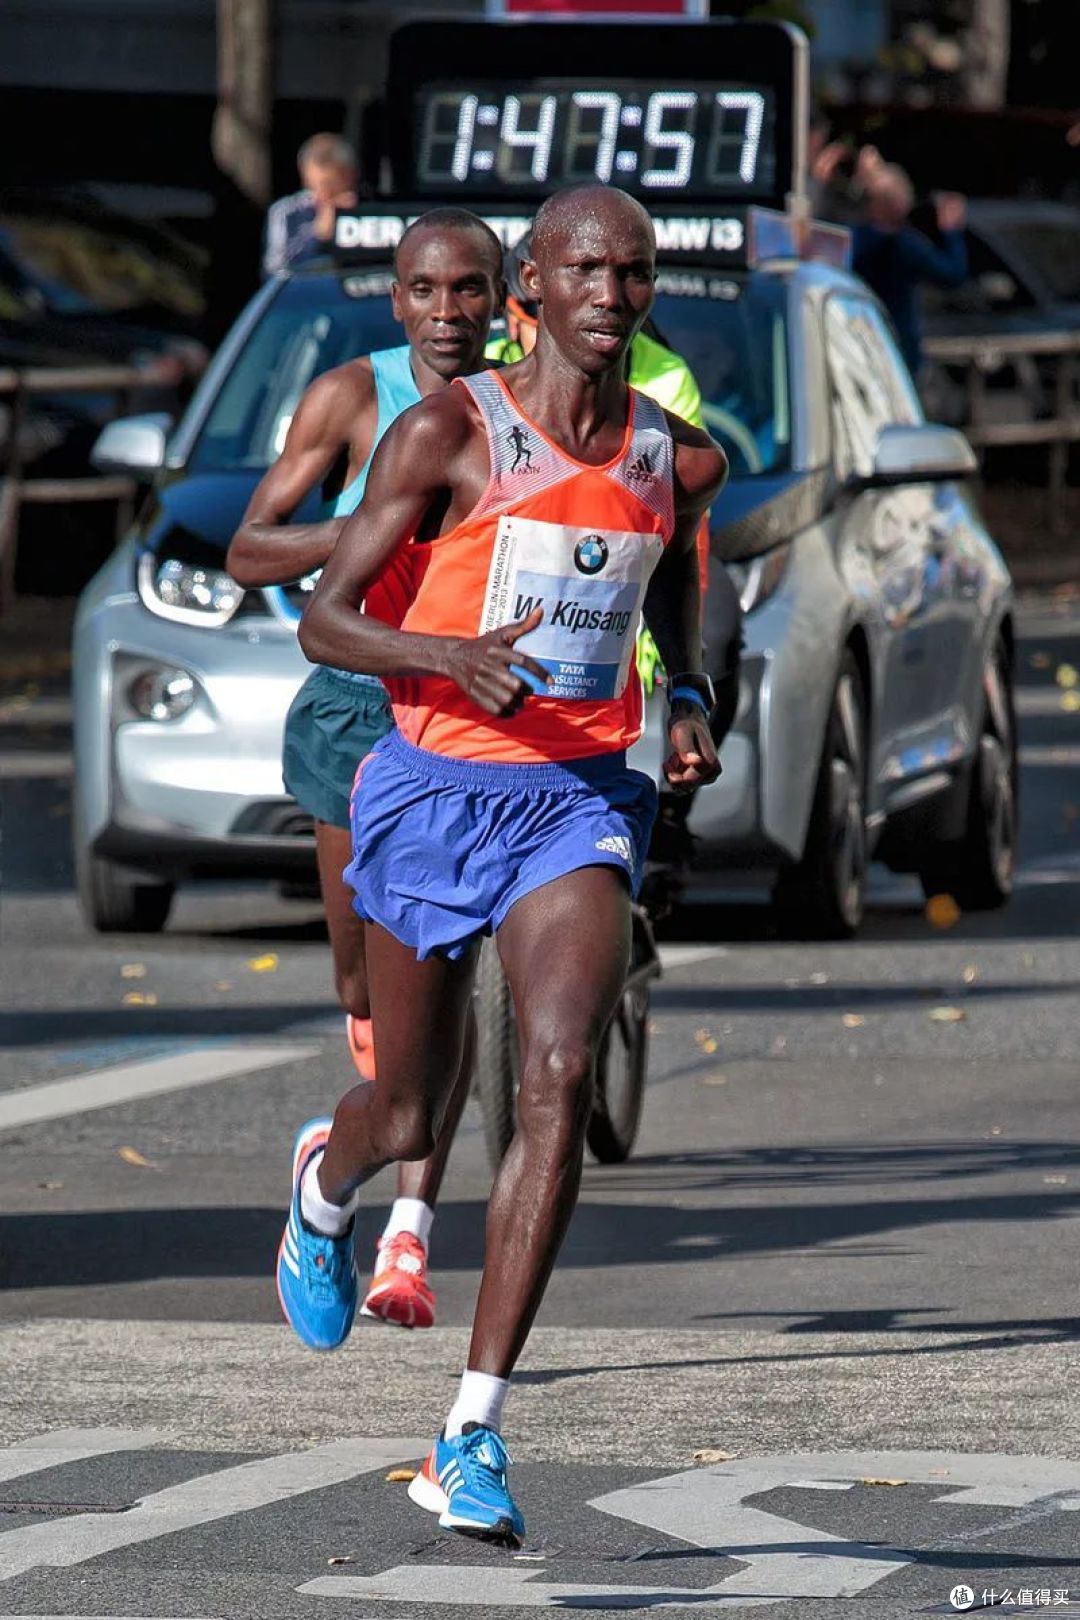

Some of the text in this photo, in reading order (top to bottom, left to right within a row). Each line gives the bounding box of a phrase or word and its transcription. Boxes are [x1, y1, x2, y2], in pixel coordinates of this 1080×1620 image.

[451, 92, 764, 187] 1:47:57
[335, 215, 404, 248] DER
[652, 217, 710, 250] MW
[550, 600, 632, 636] Kipsang
[553, 674, 599, 687] NSULTANCY
[559, 663, 585, 676] TATA
[548, 685, 587, 698] SERVICES
